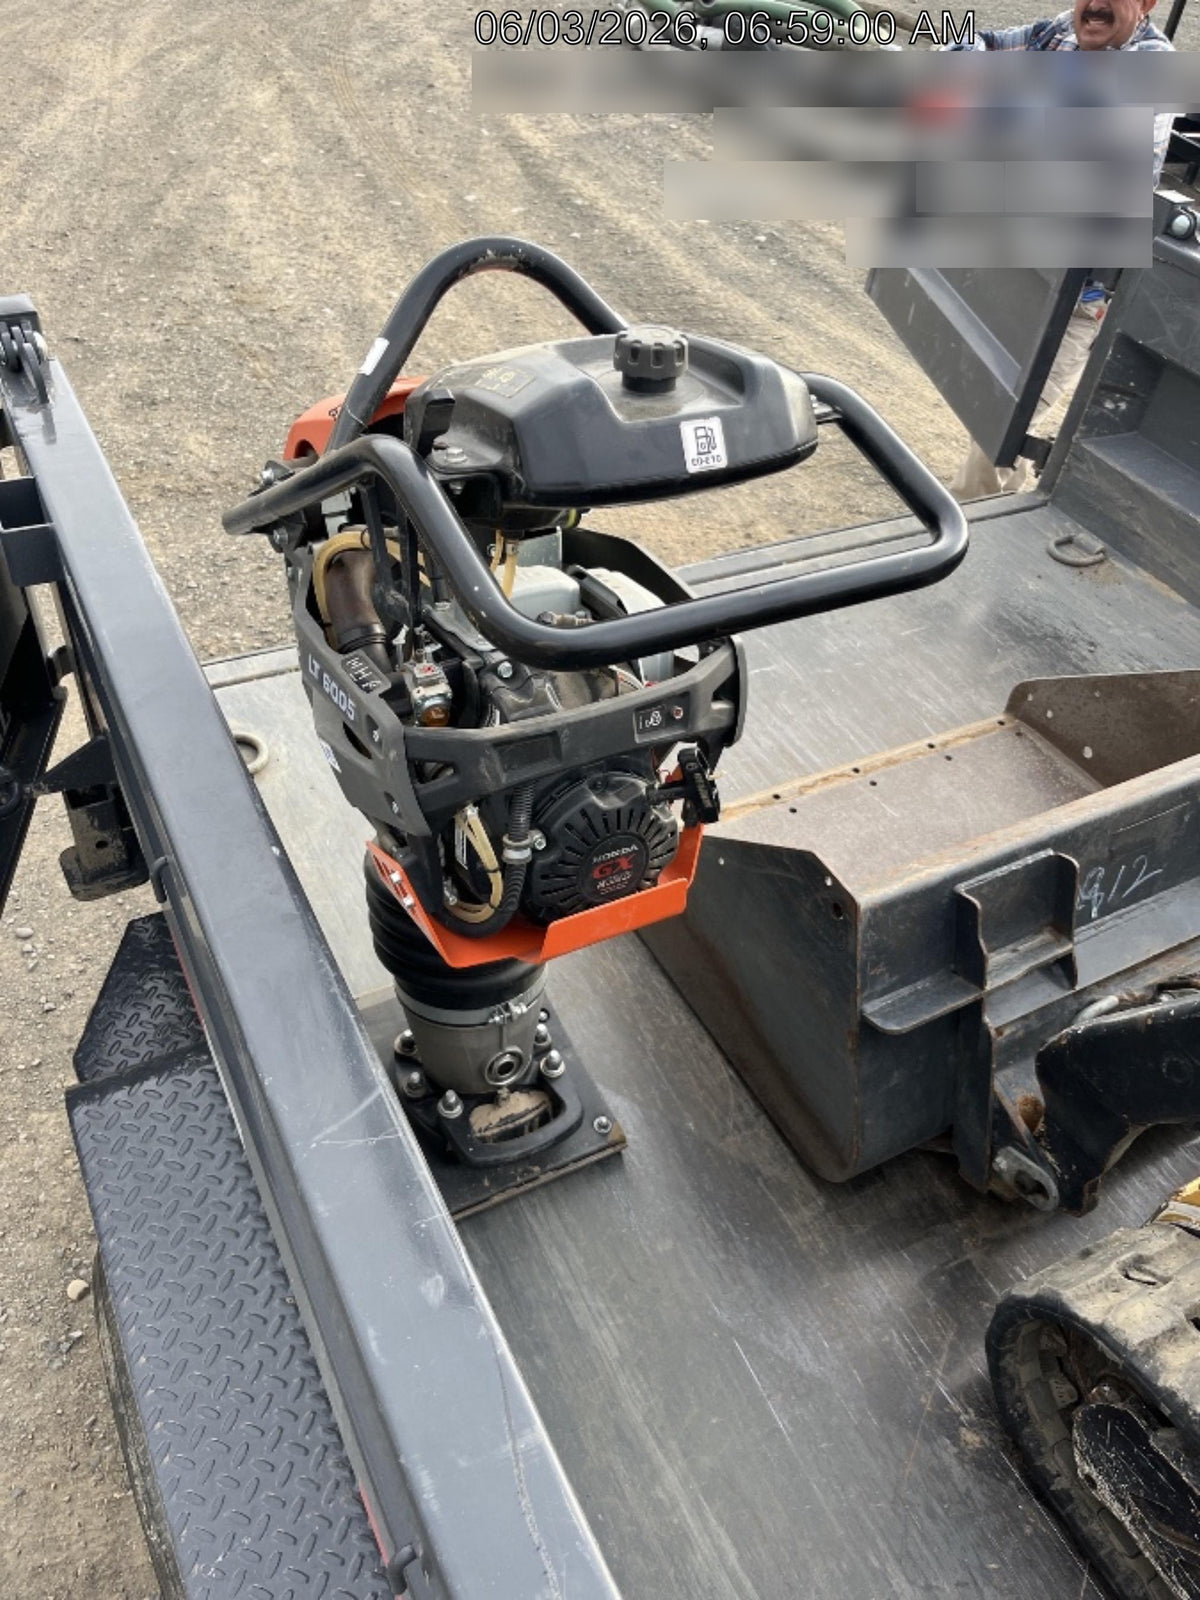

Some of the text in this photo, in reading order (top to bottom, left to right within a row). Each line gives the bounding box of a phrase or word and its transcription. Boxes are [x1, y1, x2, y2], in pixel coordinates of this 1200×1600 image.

[308, 654, 320, 680] LT
[322, 672, 357, 721] 6005
[592, 844, 639, 863] HONDA
[592, 853, 637, 879] GX
